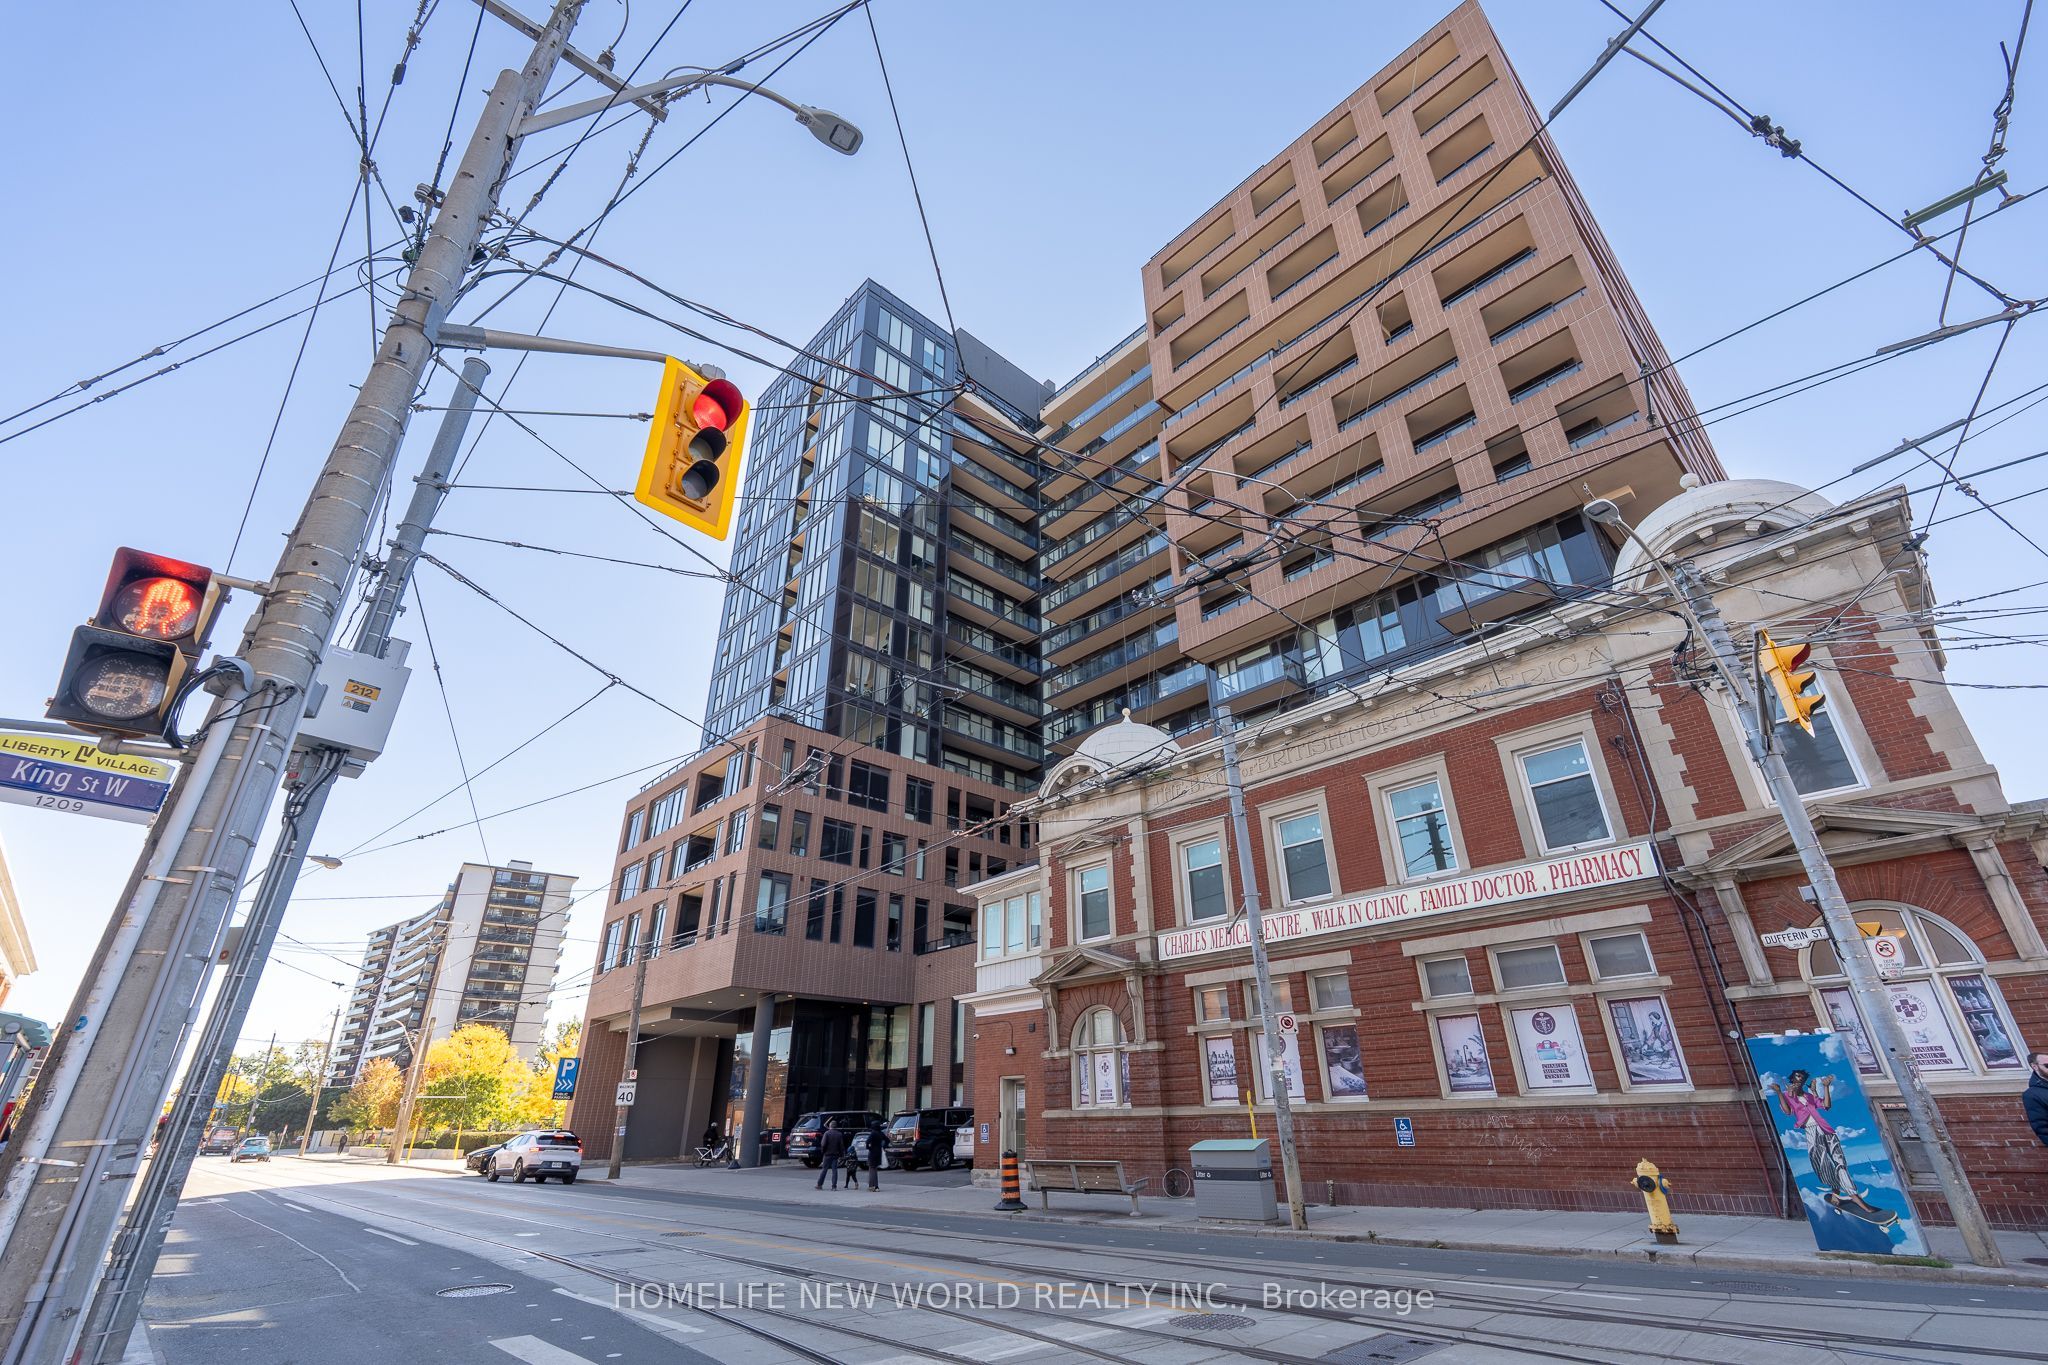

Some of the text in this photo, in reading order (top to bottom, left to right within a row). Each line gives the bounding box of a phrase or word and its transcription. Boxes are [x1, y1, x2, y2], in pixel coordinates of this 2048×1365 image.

[351, 684, 374, 698] 212
[2, 739, 70, 759] LIBERTY
[96, 756, 160, 776] VILLAGE
[11, 760, 129, 797] King St W
[35, 795, 84, 812] 1209
[1164, 848, 1644, 957] CHARLES MEDICA ENTRE WALK IN CLINIC FAMILY DOCTOR PHARMACY
[1764, 930, 1809, 945] DUFFERIN
[561, 1059, 576, 1077] P
[618, 1091, 634, 1102] 40
